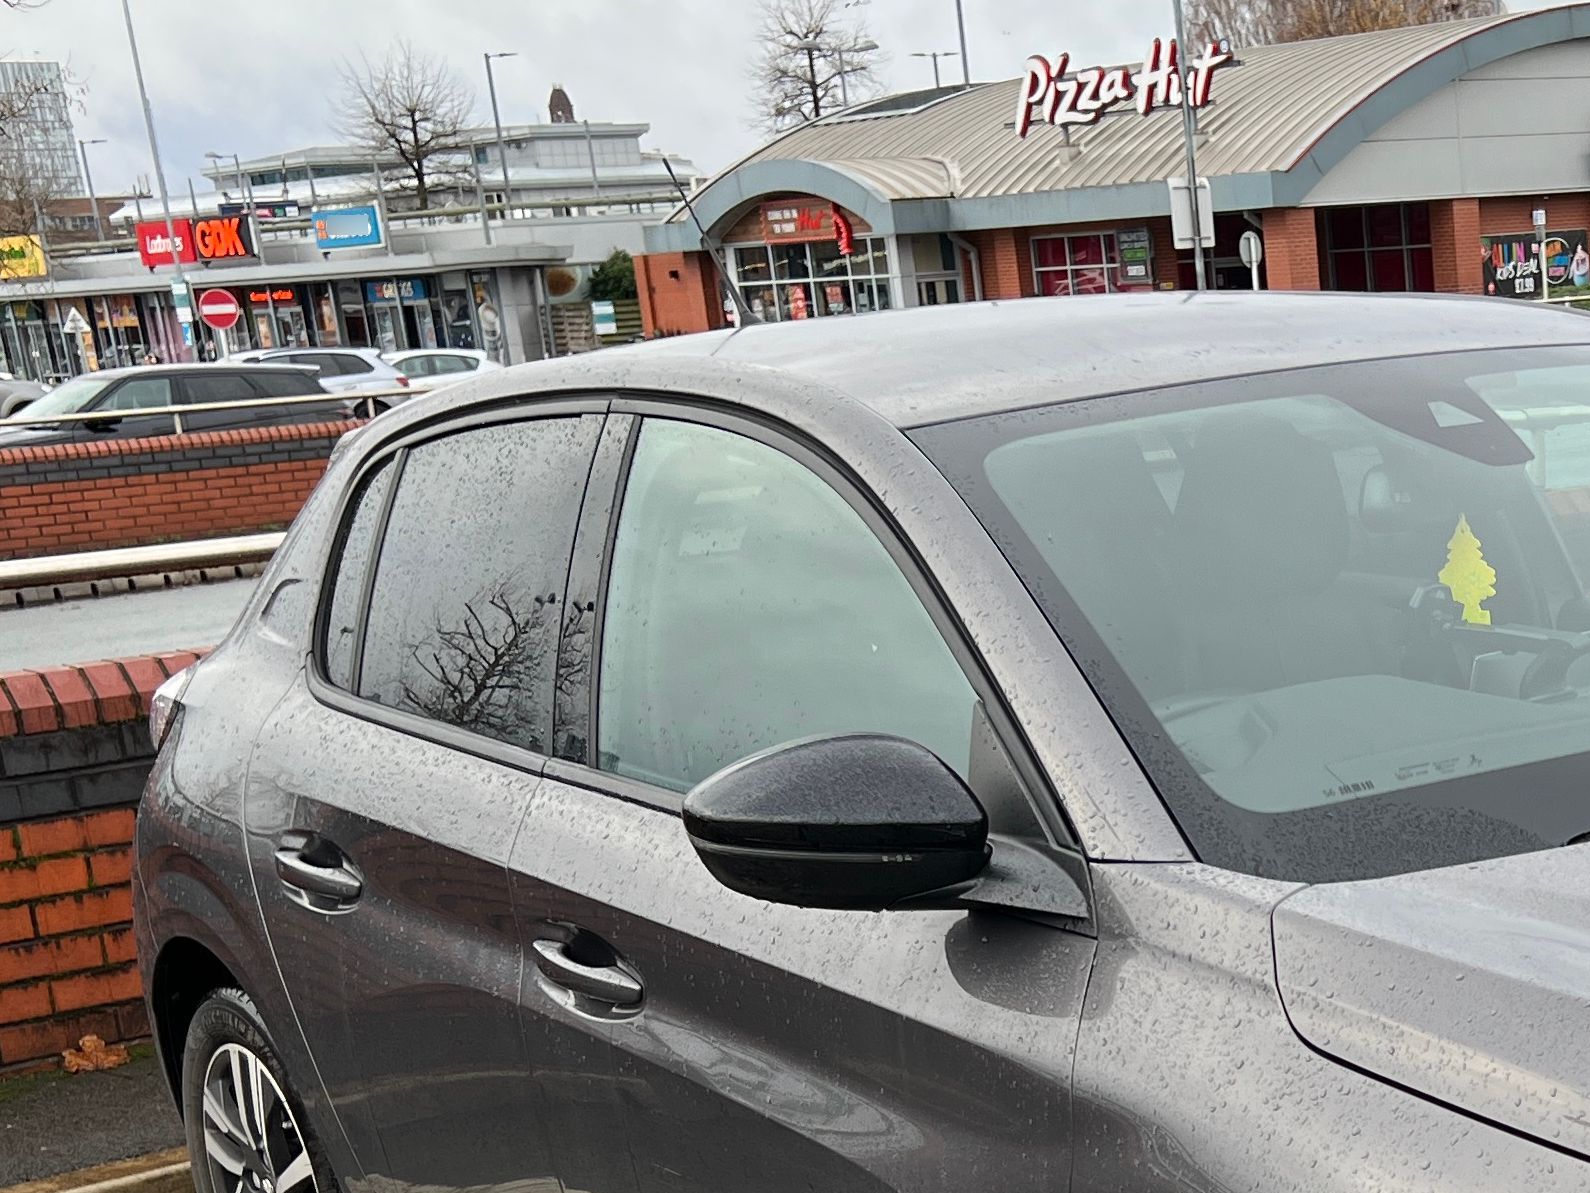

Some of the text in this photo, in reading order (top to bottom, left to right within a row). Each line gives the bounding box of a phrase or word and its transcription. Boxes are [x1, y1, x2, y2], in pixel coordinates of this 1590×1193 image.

[1015, 37, 1233, 138] Pizza Hut
[196, 217, 246, 257] GDK
